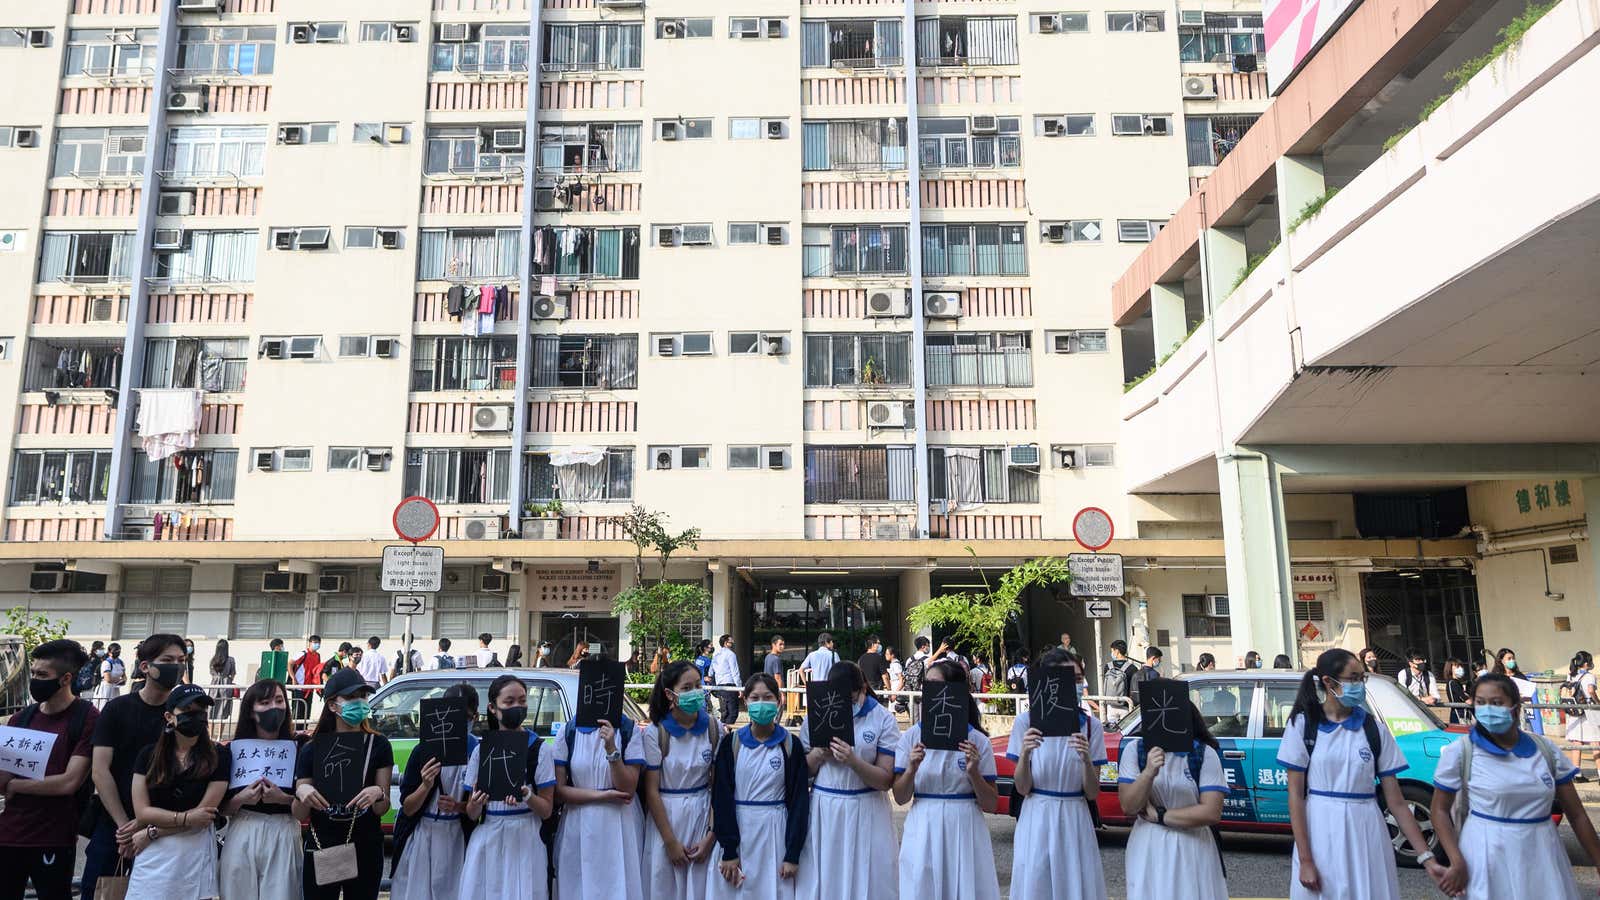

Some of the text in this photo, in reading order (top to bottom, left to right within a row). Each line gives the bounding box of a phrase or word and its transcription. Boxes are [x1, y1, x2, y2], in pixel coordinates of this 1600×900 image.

[1515, 479, 1571, 514] 德和樓
[583, 673, 617, 716] 時
[814, 691, 846, 732] 港
[928, 686, 962, 738] 香
[1032, 677, 1074, 721] 復
[1147, 689, 1188, 735] 光
[3, 736, 46, 752] 大訴求
[426, 705, 461, 756] 革
[1393, 720, 1422, 732] POAD
[1, 757, 40, 772] 一不可
[235, 766, 287, 779] 缺一不可
[237, 747, 289, 761] 五大訴求
[323, 737, 354, 793] 命
[482, 744, 518, 788] 代
[1258, 768, 1288, 786] 退休
